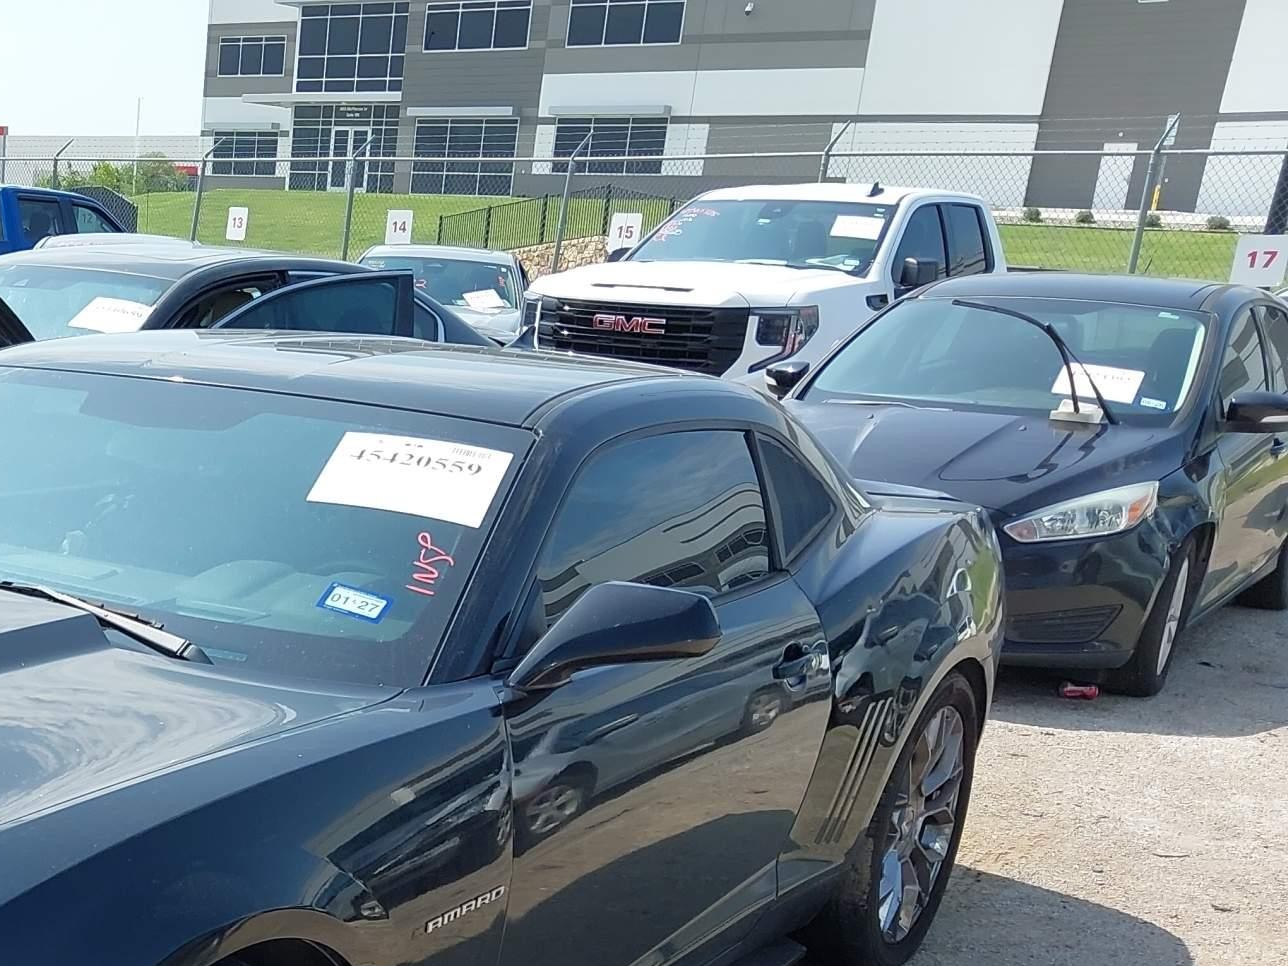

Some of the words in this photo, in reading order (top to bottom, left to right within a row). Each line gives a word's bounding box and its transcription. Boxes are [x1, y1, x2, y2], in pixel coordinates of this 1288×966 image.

[232, 216, 244, 229] 13
[392, 220, 407, 233] 14
[617, 225, 634, 239] 15
[1247, 250, 1279, 269] 17
[593, 314, 666, 335] GMC
[350, 448, 483, 476] 45420559
